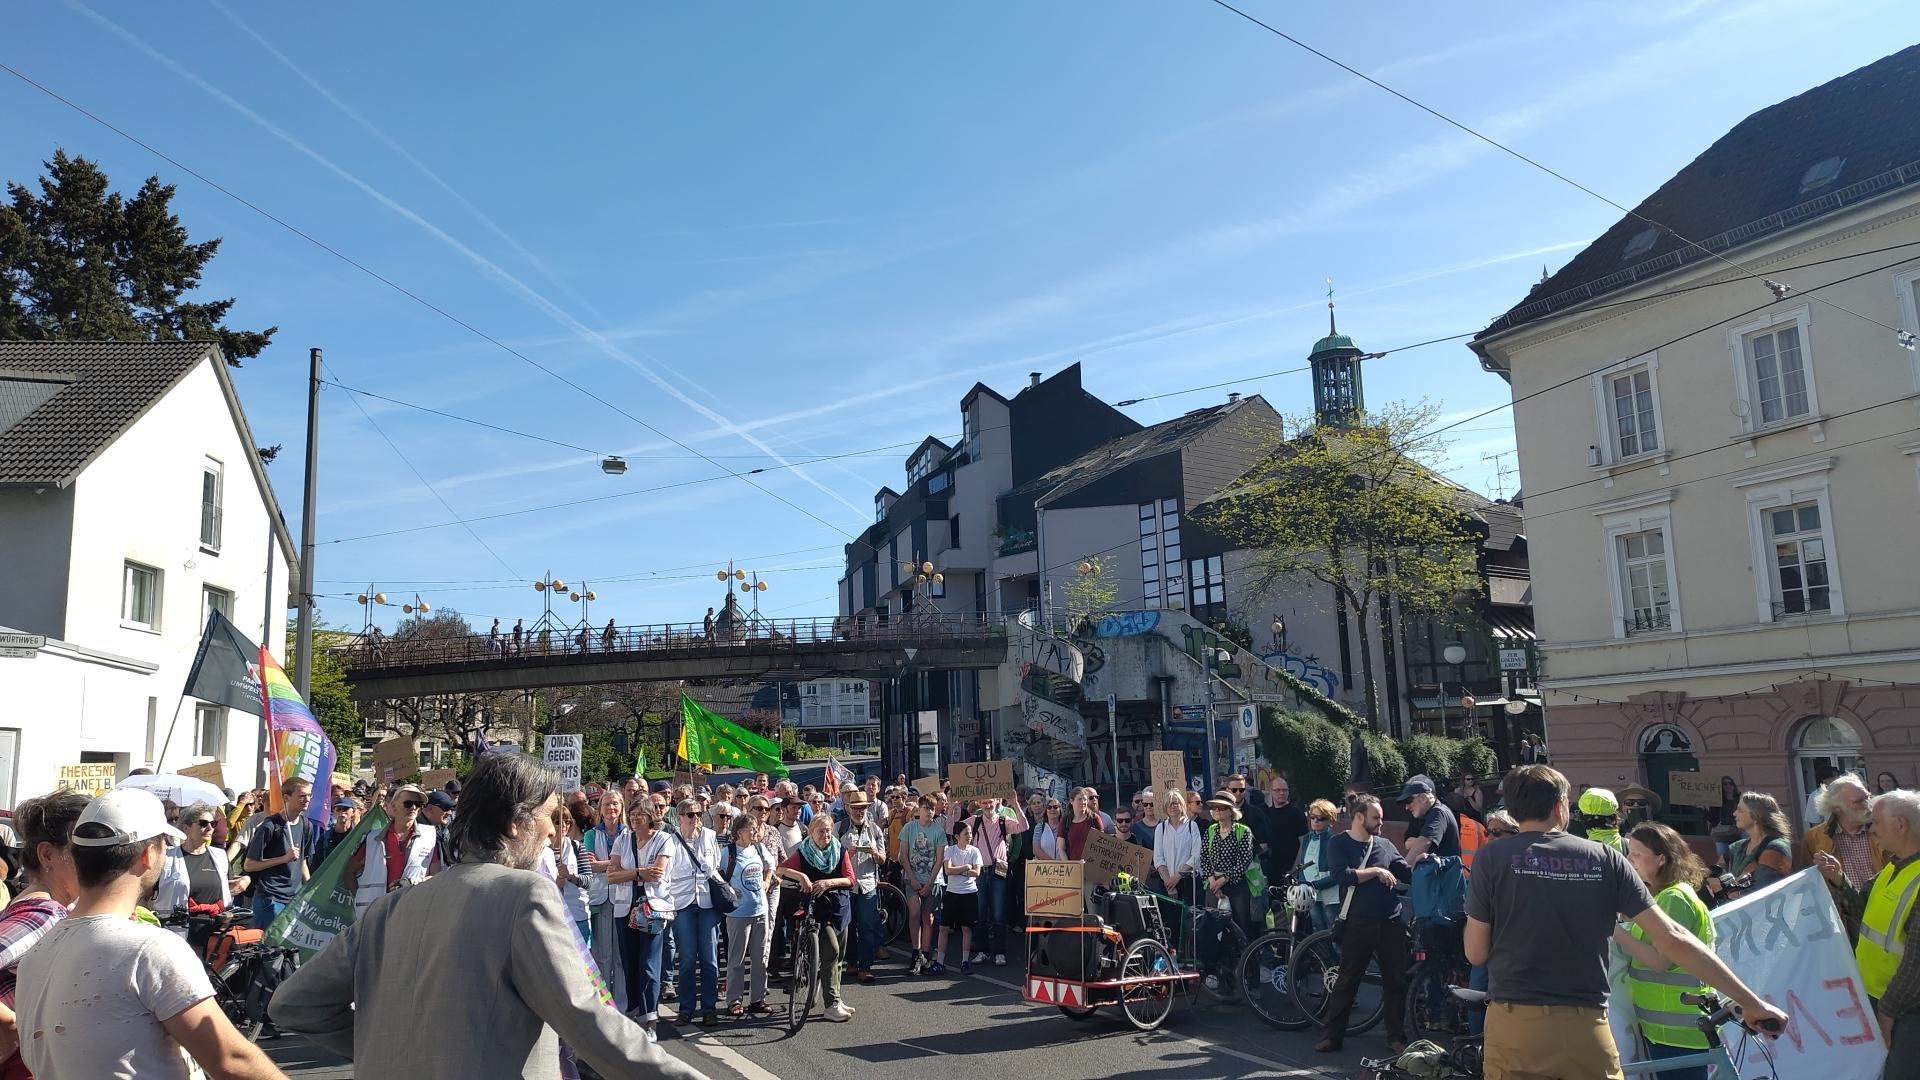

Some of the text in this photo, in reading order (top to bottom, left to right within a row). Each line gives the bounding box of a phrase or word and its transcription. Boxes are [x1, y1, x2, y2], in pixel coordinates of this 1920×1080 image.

[551, 736, 574, 748] OMAS
[547, 749, 576, 762] GEGEN
[1152, 753, 1184, 768] SYSTEM
[103, 765, 116, 777] NO
[561, 765, 579, 778] HTS
[964, 763, 997, 779] CDU
[58, 778, 102, 790] PLANET
[1164, 779, 1176, 790] NOT
[1034, 864, 1075, 877] MACHEN
[305, 933, 325, 947] Ihr
